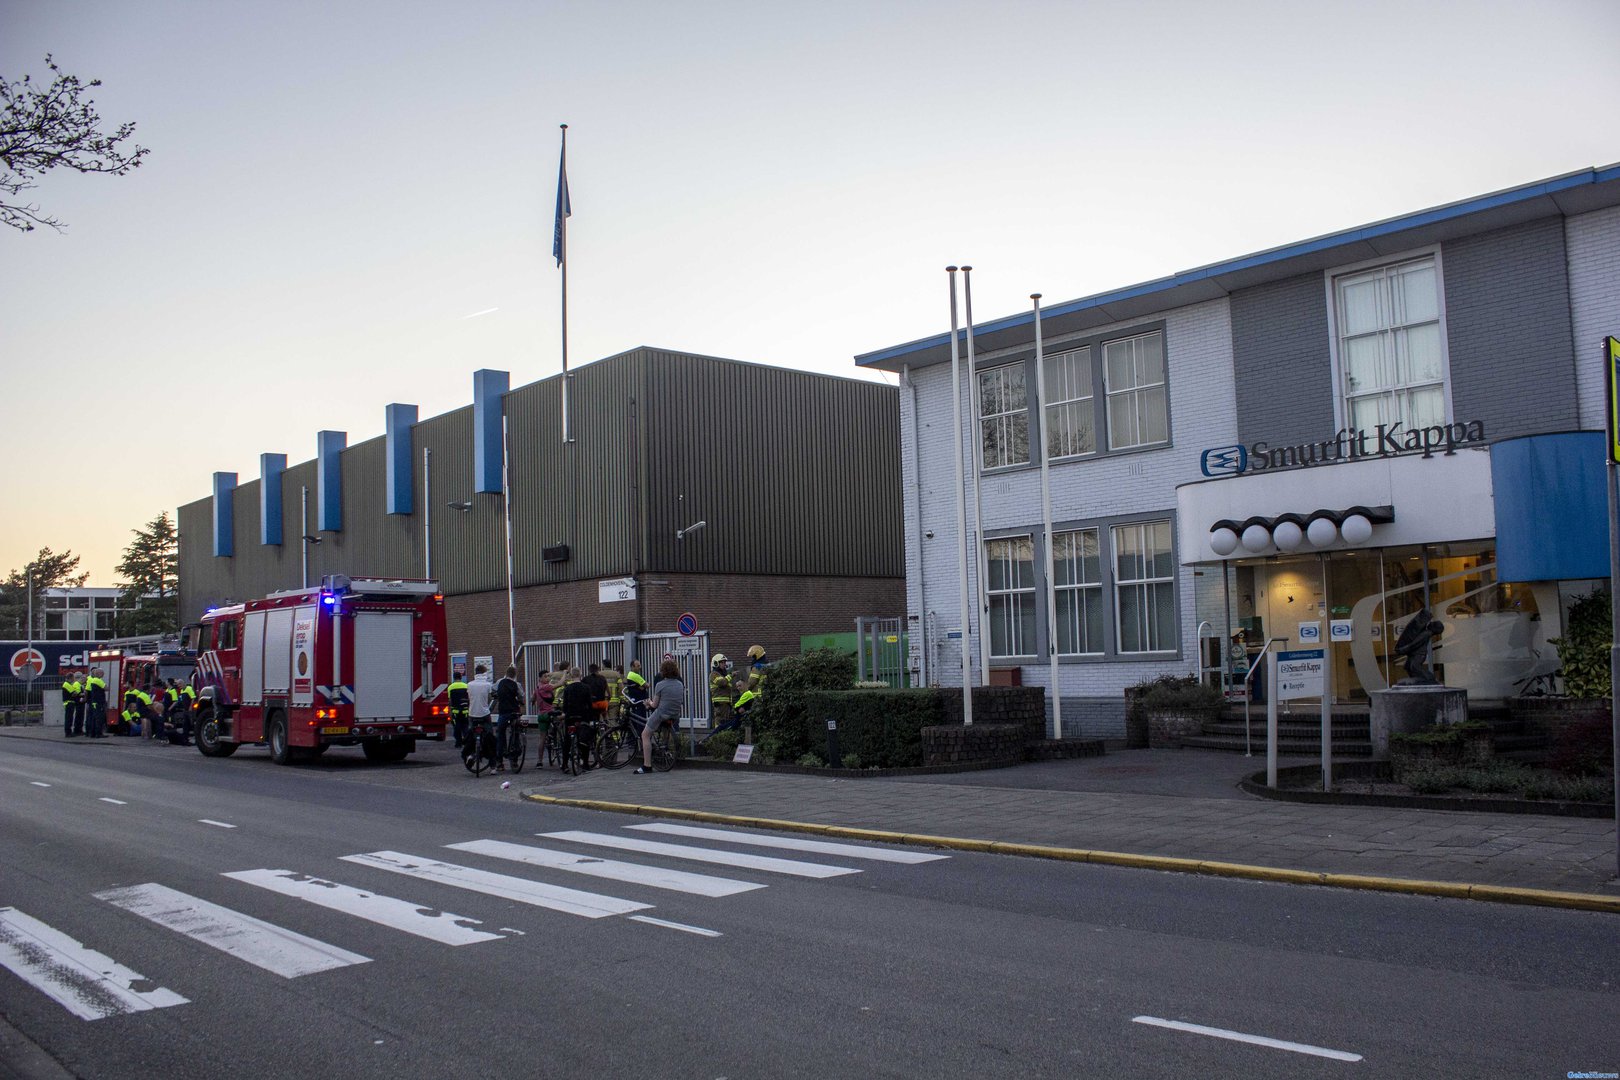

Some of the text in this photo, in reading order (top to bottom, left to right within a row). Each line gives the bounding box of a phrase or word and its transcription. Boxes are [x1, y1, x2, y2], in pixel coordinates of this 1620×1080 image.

[1250, 418, 1487, 471] Smurfit Kappa
[618, 590, 629, 599] 122
[1289, 661, 1321, 674] Smurfit Kappa
